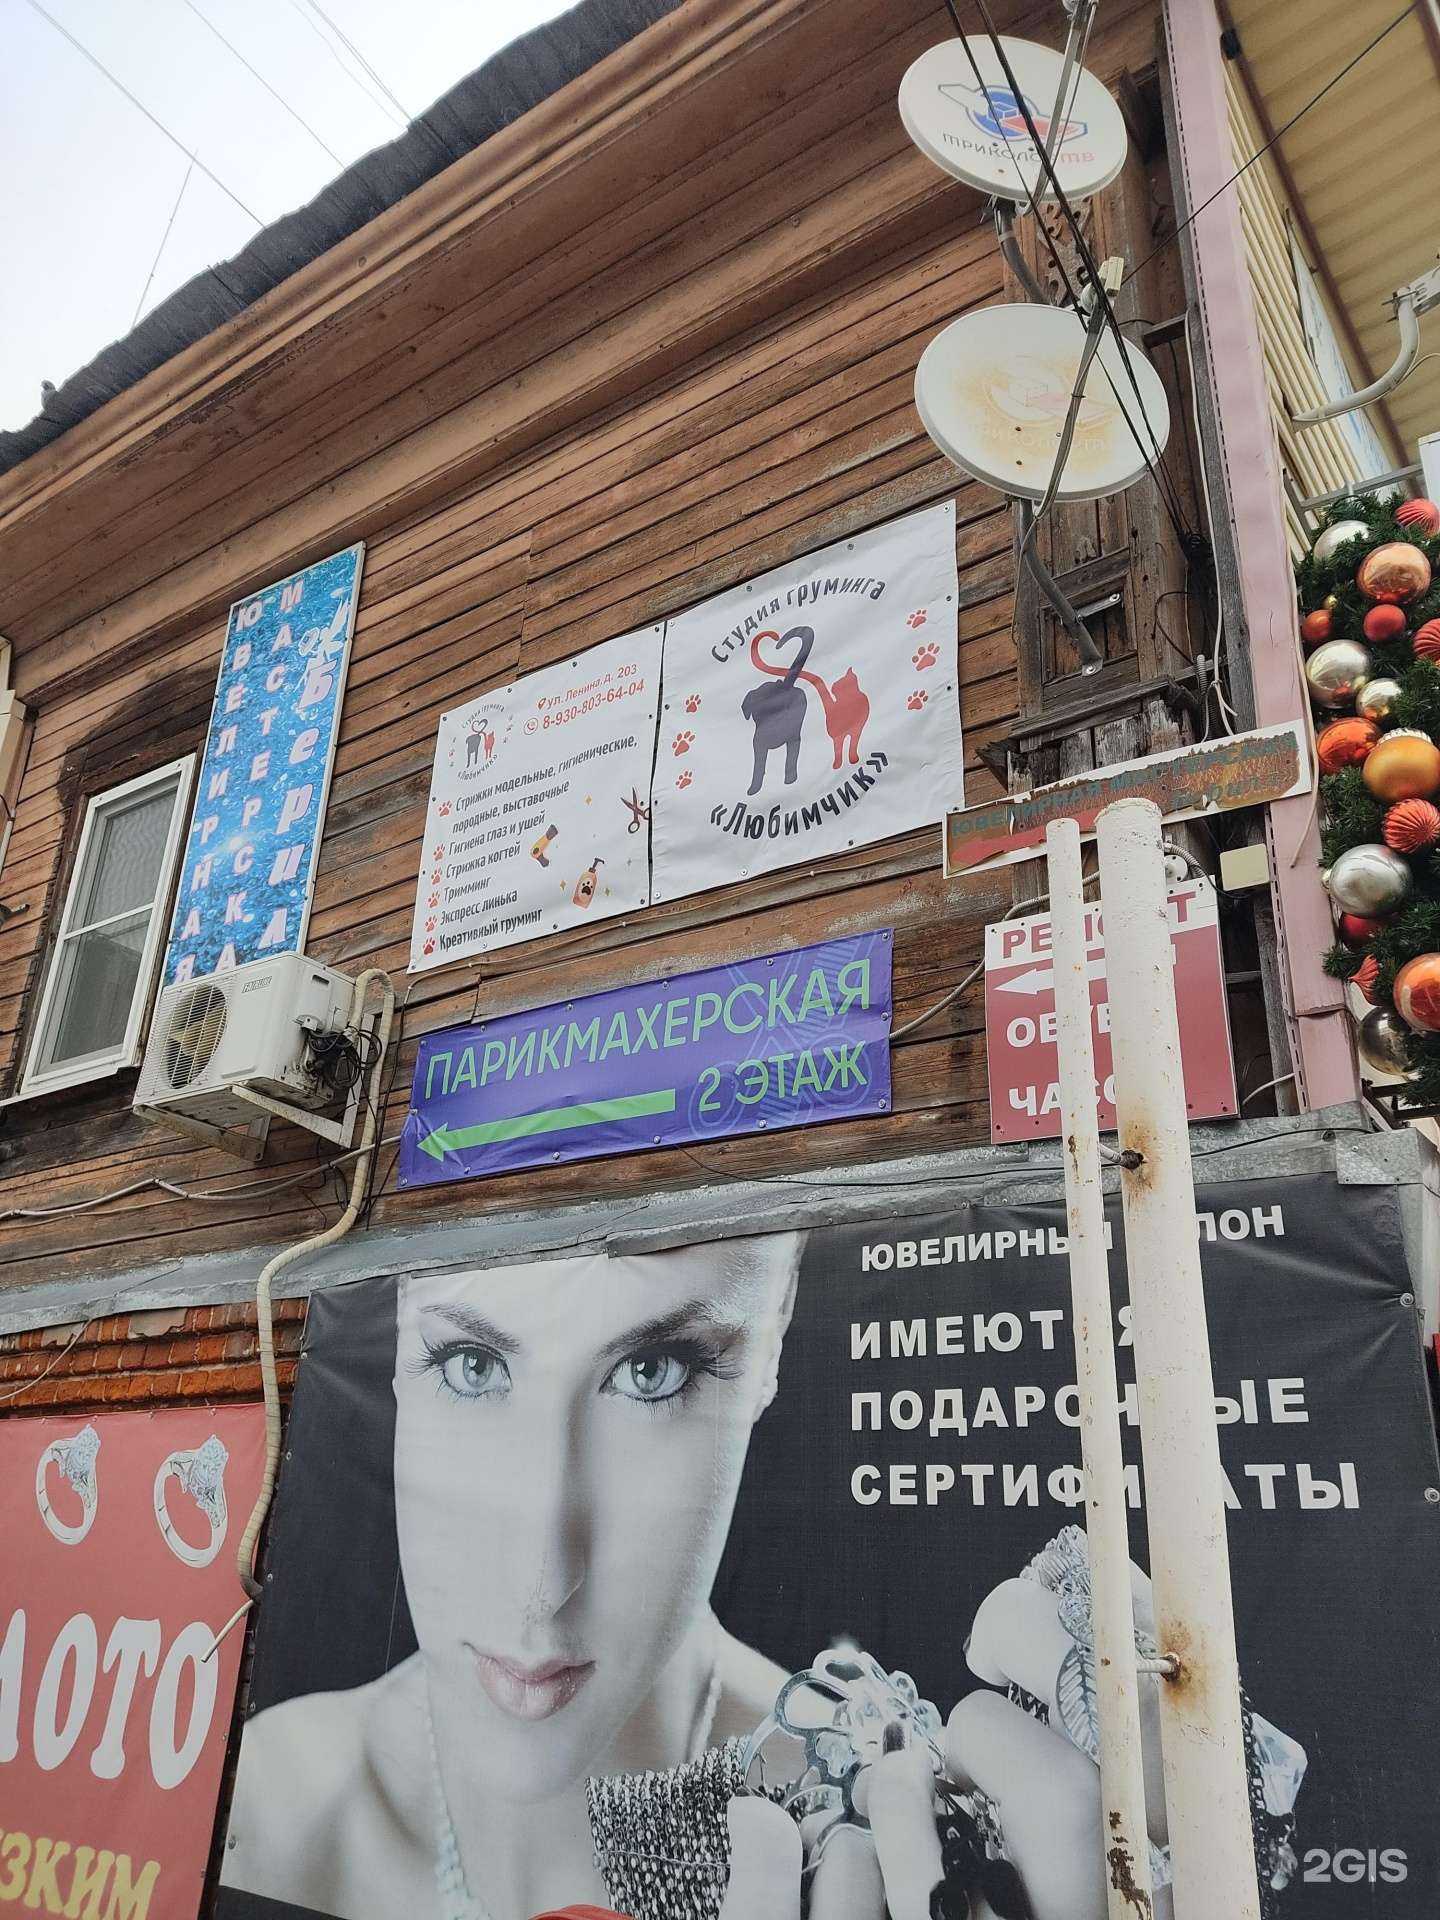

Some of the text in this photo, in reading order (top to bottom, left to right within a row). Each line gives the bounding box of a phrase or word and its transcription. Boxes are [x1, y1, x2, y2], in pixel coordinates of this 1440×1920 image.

[711, 576, 886, 663] Студия груминга
[542, 678, 645, 729] 8-930-803-64-04
[547, 696, 564, 709] ул.
[617, 664, 637, 679] 203
[456, 735, 638, 813] Стрижки модельные, гигиенические,
[710, 751, 888, 840] «Любимчик»
[452, 780, 570, 834] породные, выставочные
[449, 810, 546, 856] Гигиена глаз и ушей
[446, 840, 521, 879] Стрижка когтей
[440, 889, 518, 926] Экспресс линька
[444, 876, 491, 903] Тримминг
[440, 909, 543, 952] Креативный груминг
[425, 958, 871, 1099] ПАРИКМАХЕРСКАЯ
[699, 1042, 868, 1112] 2 ЭТАЖ
